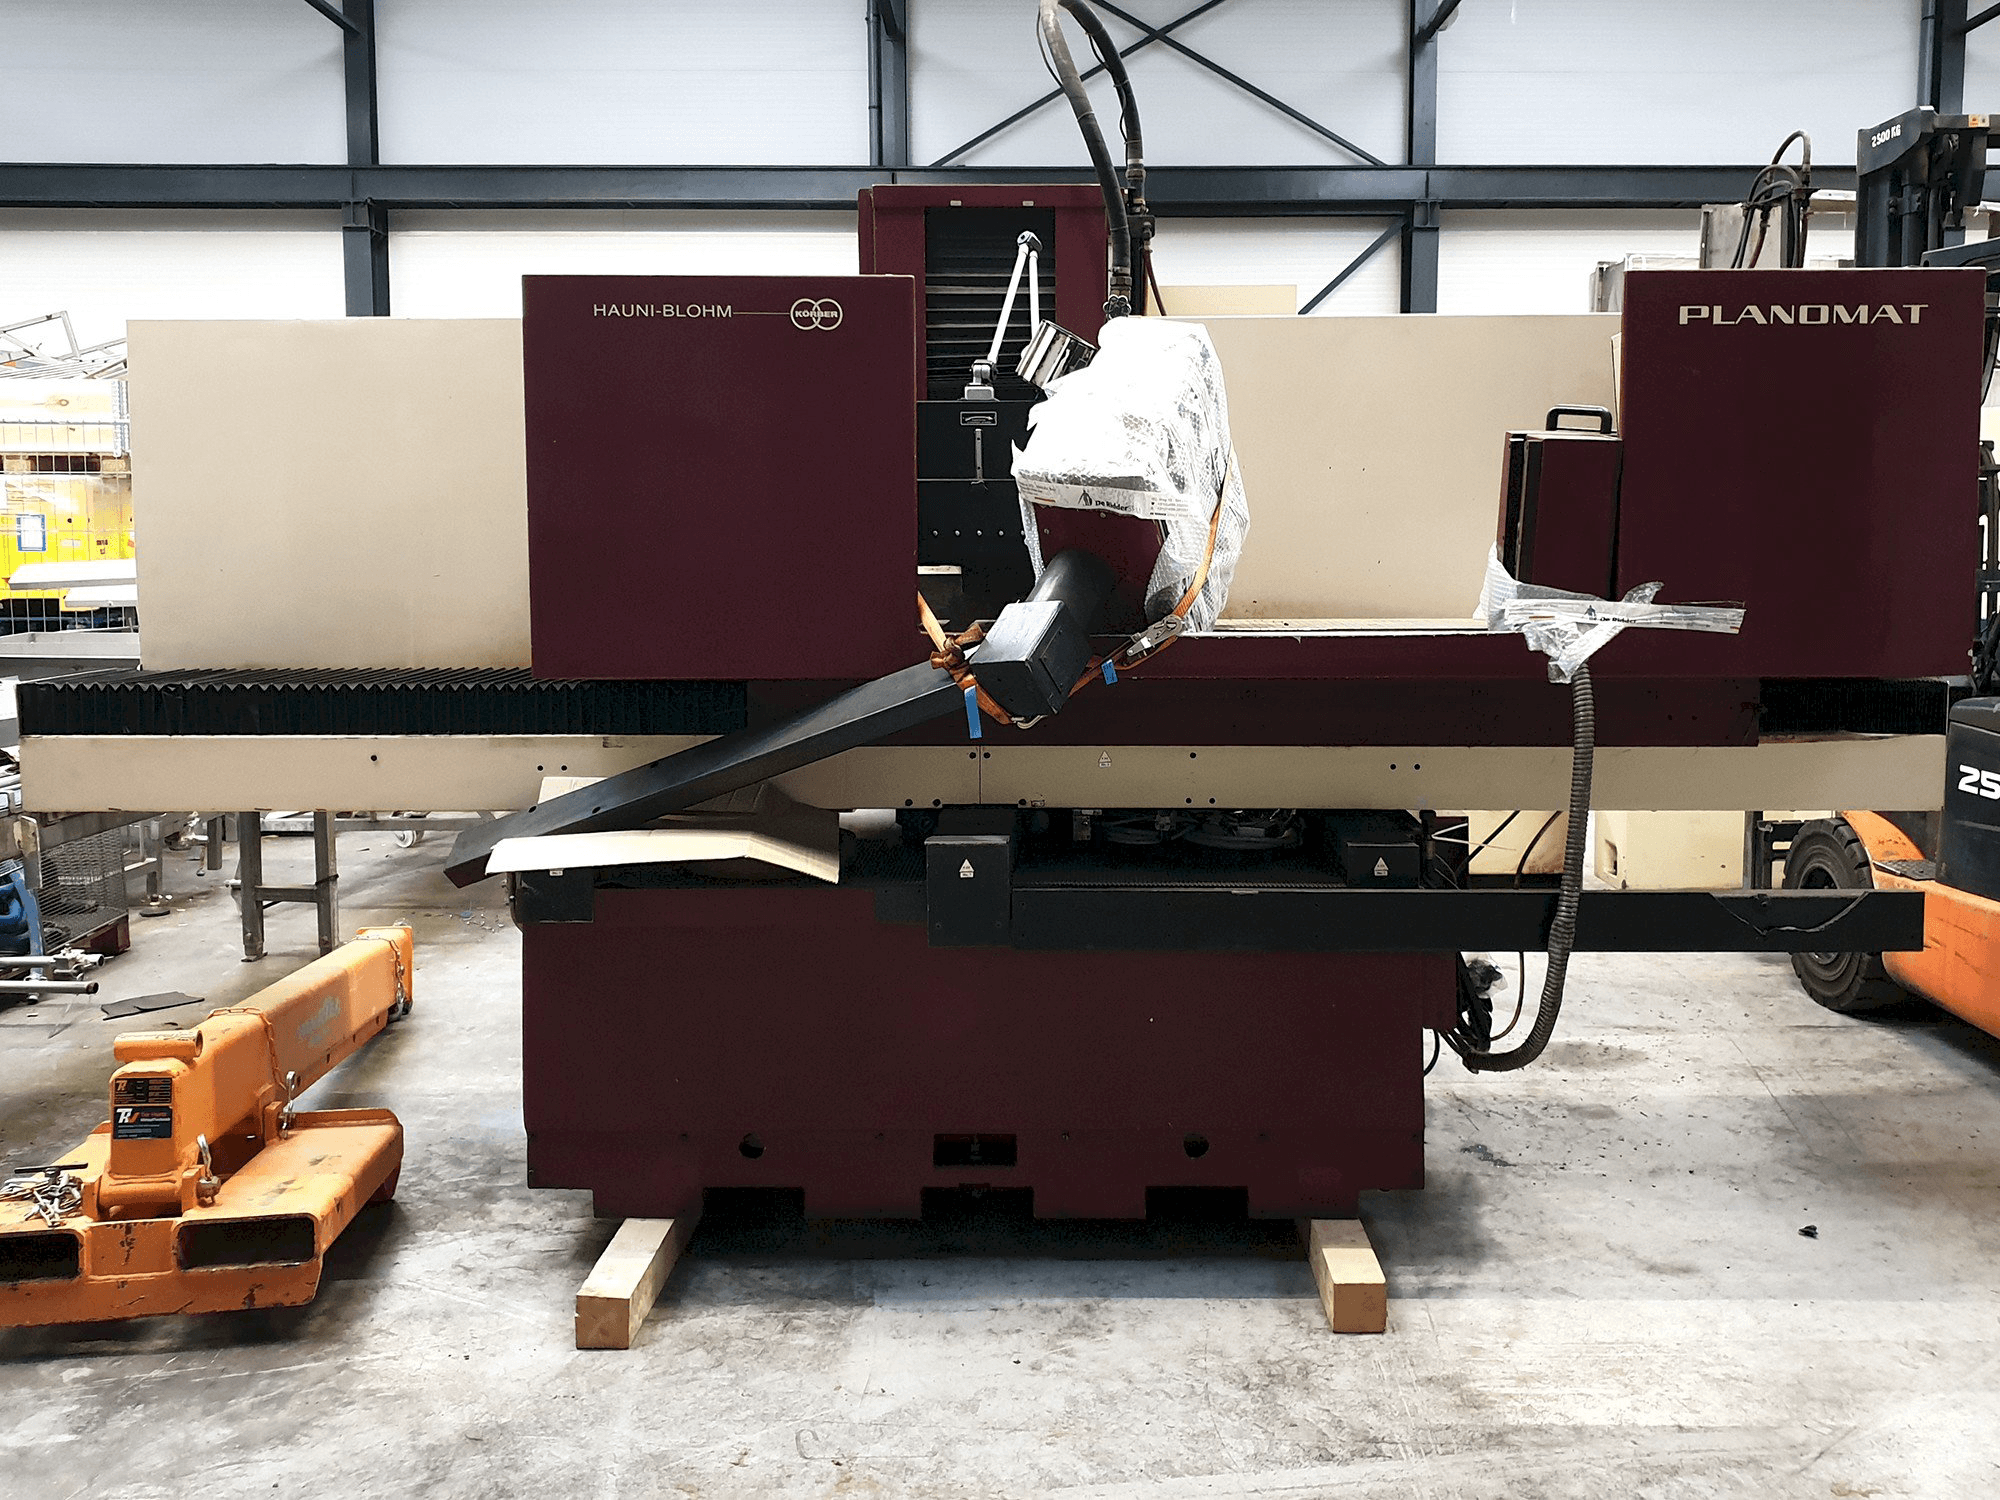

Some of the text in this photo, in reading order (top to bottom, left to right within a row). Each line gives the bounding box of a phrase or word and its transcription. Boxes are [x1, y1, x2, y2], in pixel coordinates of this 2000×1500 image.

[1871, 124, 1902, 148] 2500 KG
[593, 304, 732, 318] HAUNI-BLOHM
[1679, 304, 1929, 325] PLANOMAT
